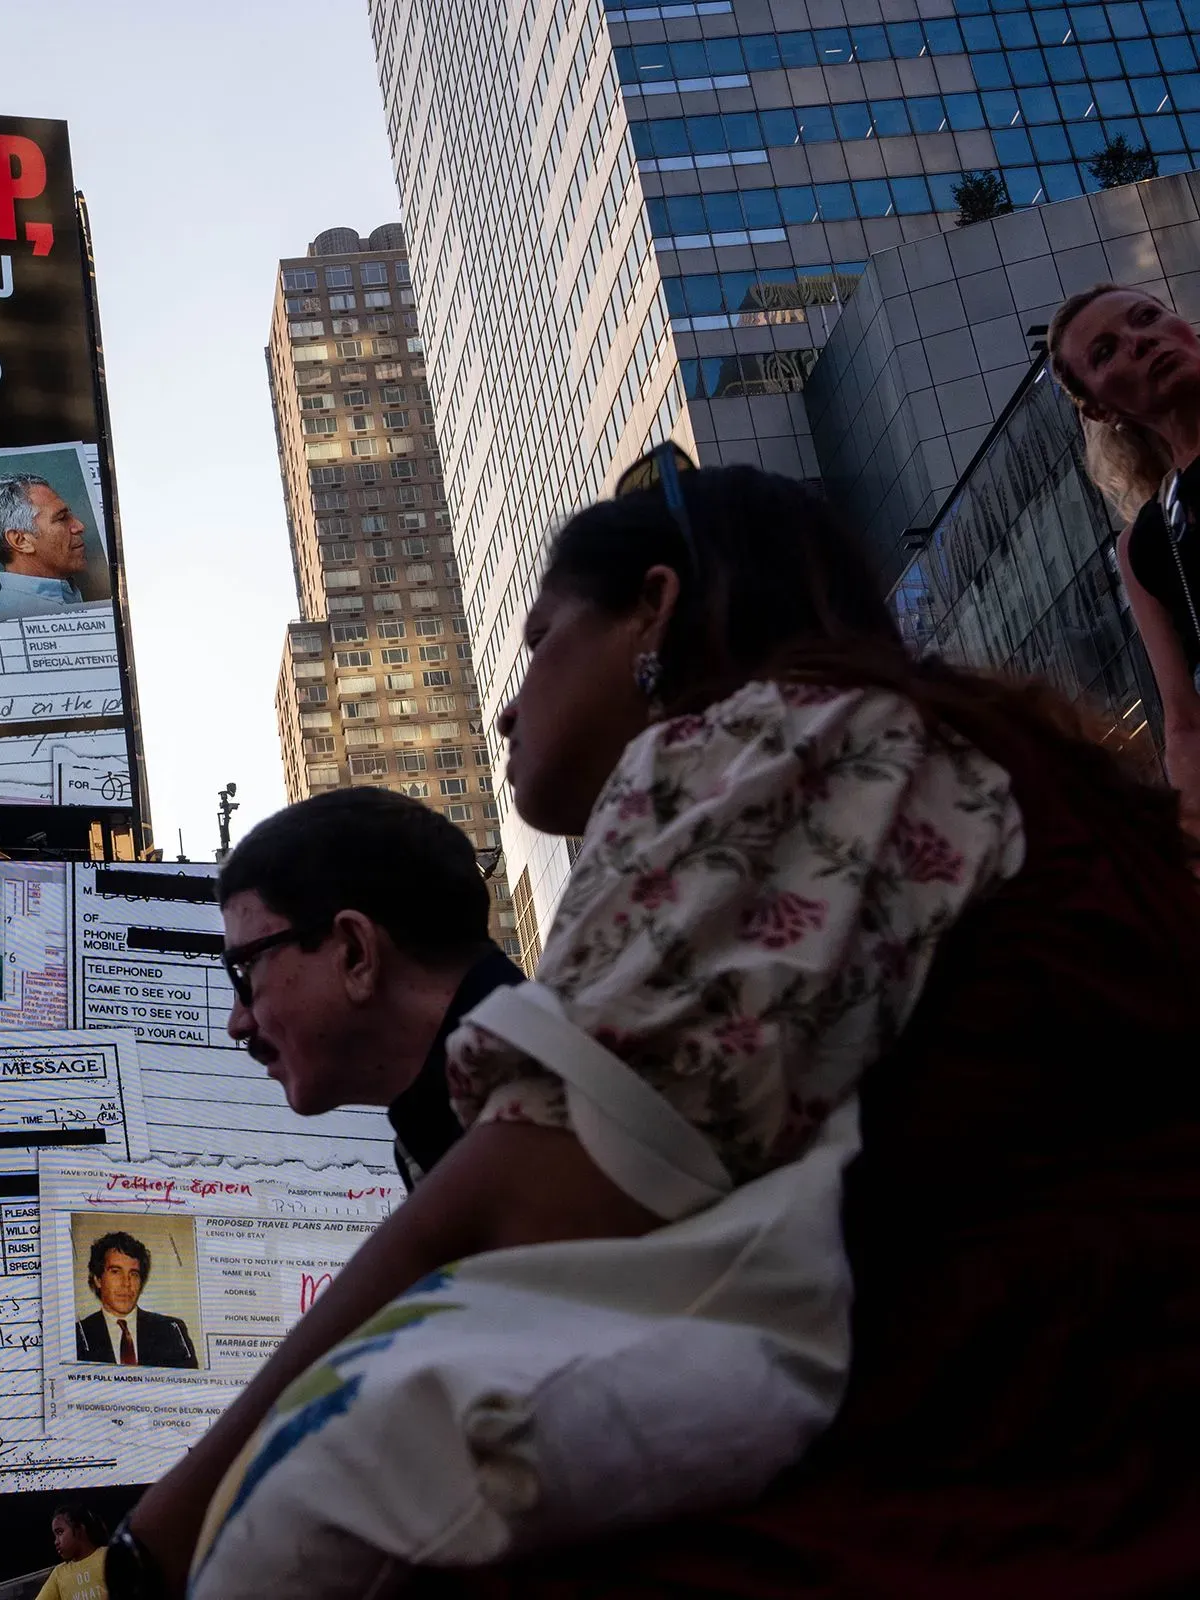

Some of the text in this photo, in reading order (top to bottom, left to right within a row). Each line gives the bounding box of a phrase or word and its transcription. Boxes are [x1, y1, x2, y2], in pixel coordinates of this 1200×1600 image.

[26, 620, 106, 634] WILL CALL AGAIN
[29, 641, 57, 651] RUSH
[32, 656, 73, 668] SPECIAL
[68, 780, 90, 790] FOR
[83, 886, 93, 896] M
[83, 913, 99, 923] OF
[83, 929, 127, 942] PHONE/
[83, 940, 126, 952] MOBILE
[88, 964, 163, 978] TELEPHONED
[88, 983, 191, 1000] CAME TO SEE YOU
[88, 1003, 200, 1021] WANTS TO SEE YOU
[147, 1027, 177, 1038] YOUR
[180, 1030, 204, 1041] CALL
[2, 1059, 98, 1076] MESSAGE
[21, 1116, 43, 1124] TIME
[288, 1189, 322, 1197] PASSPORT
[4, 1209, 40, 1218] PLEASE
[206, 1219, 343, 1231] PROPOSED TRAVEL PLANS AND
[6, 1227, 27, 1236] WILL
[8, 1244, 35, 1253] RUSH
[253, 1270, 272, 1278] FULL
[215, 1339, 258, 1347] MARRIAGE
